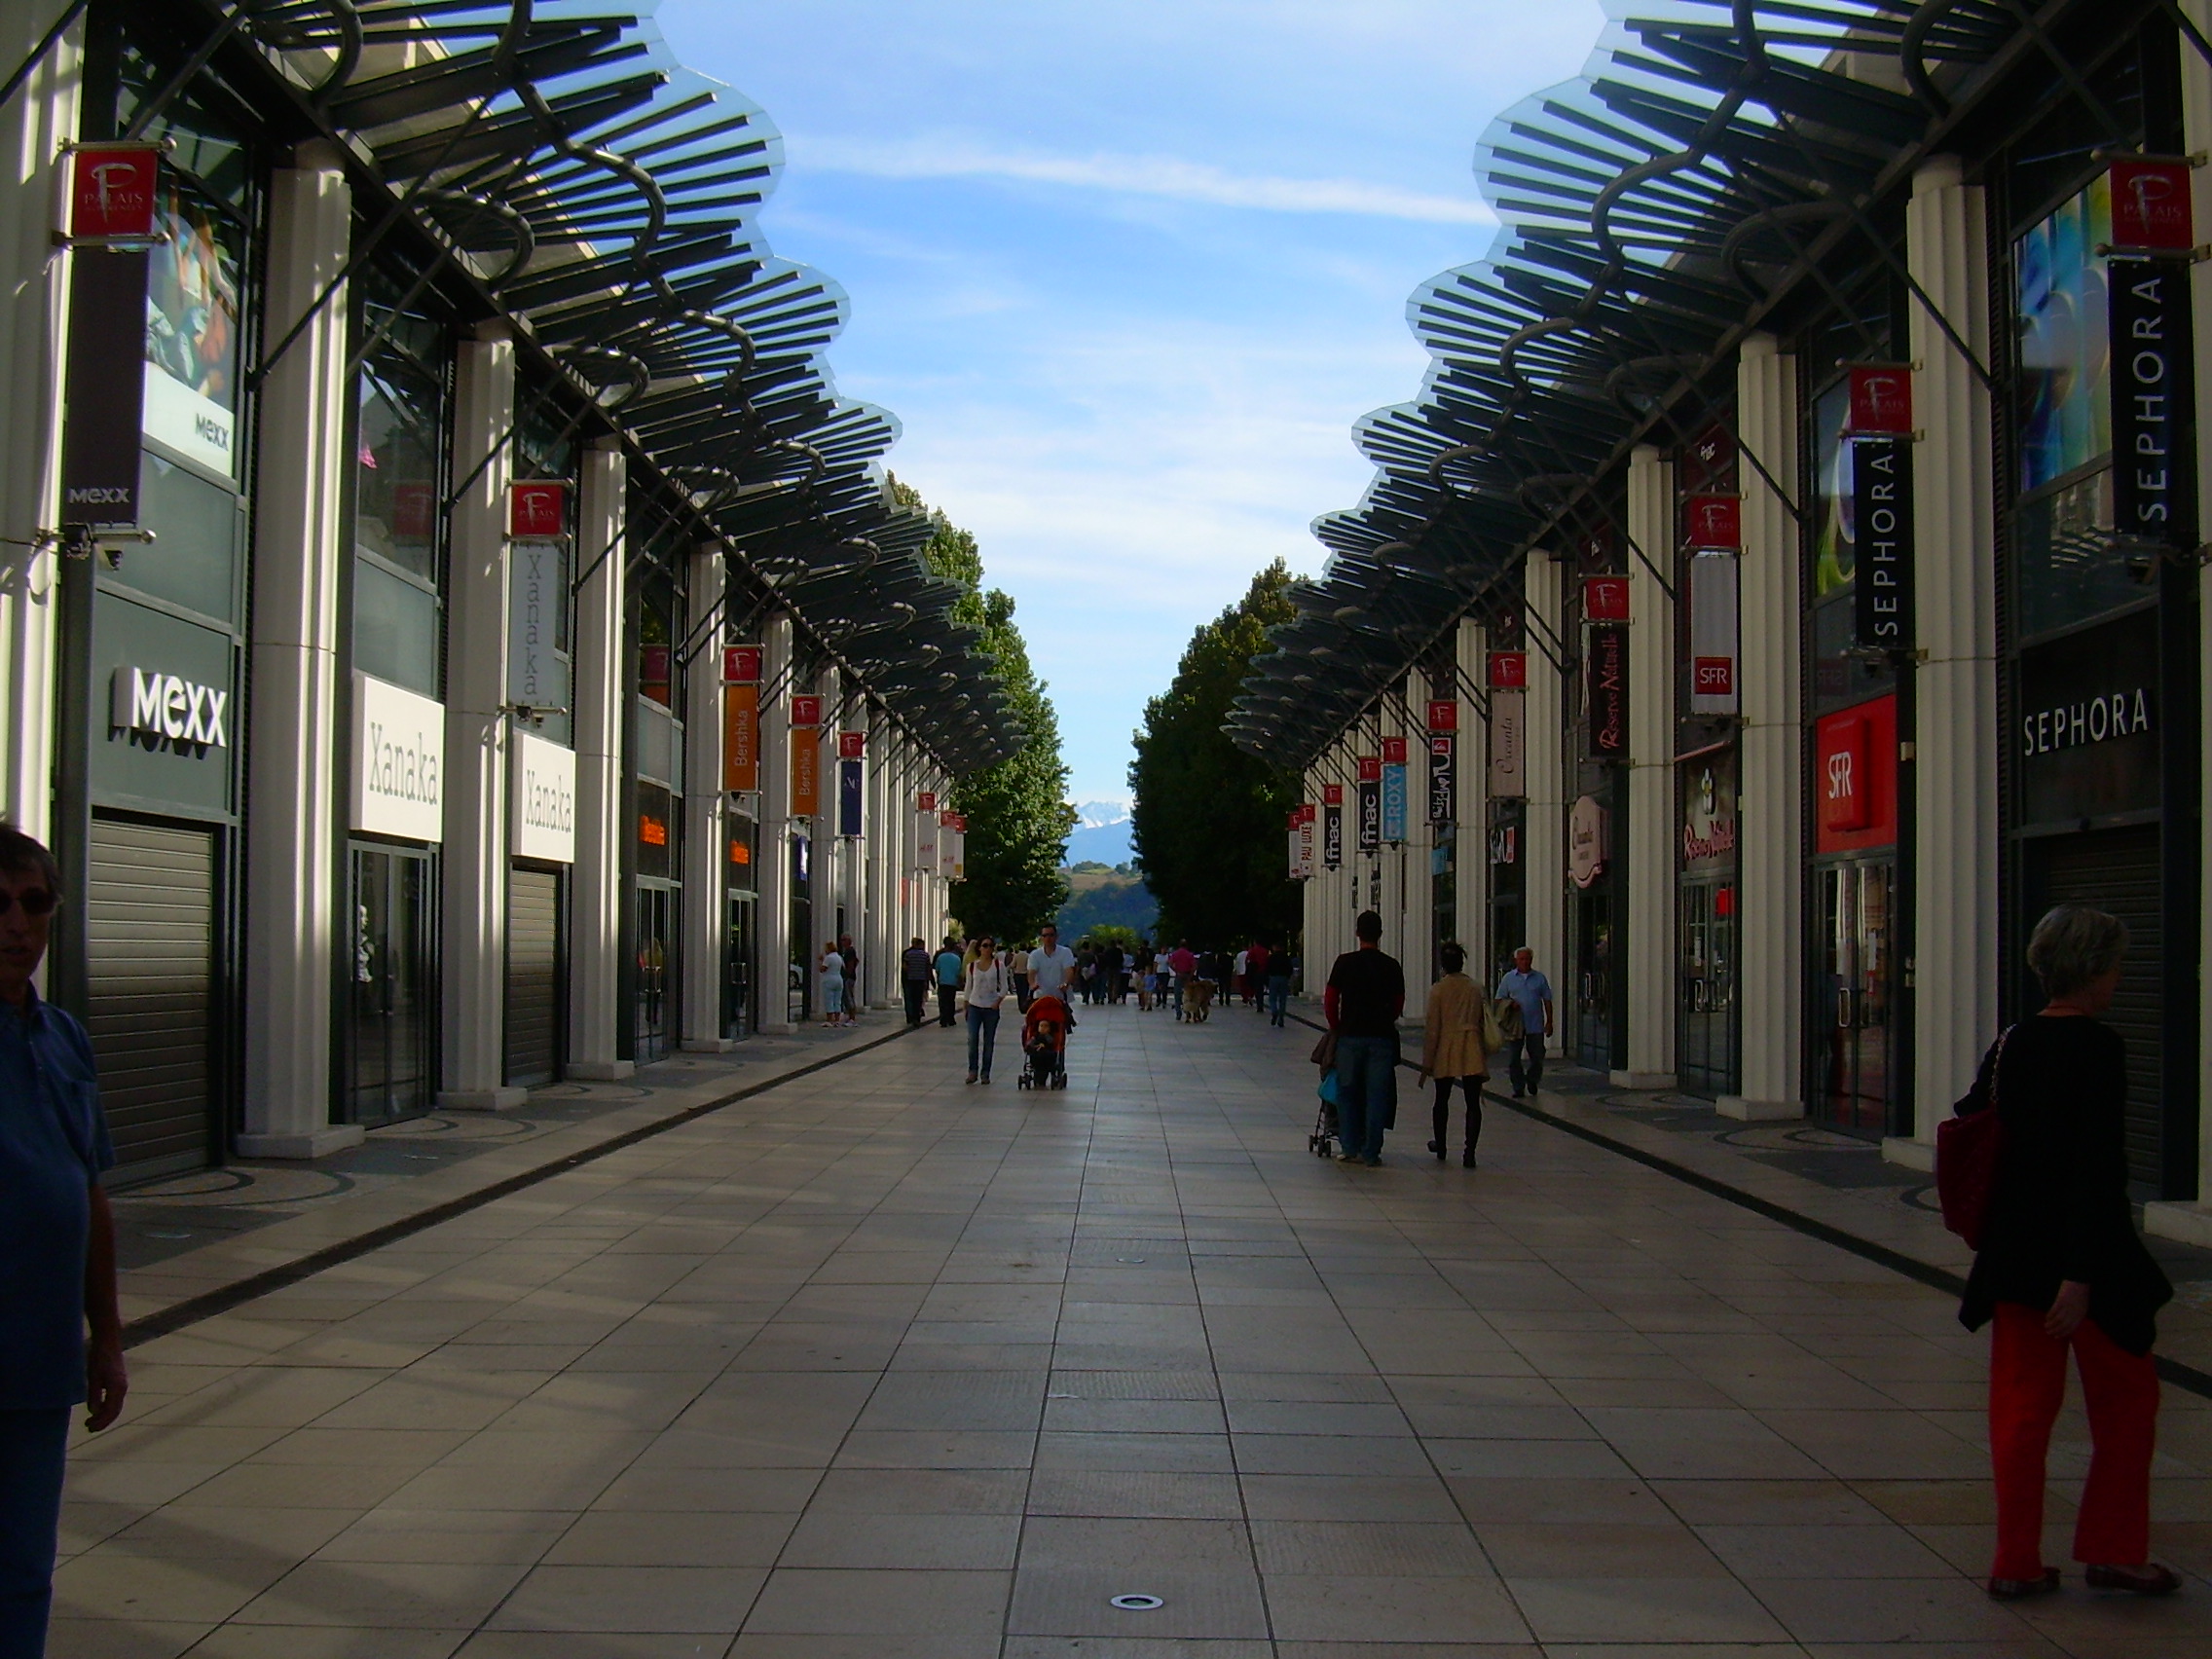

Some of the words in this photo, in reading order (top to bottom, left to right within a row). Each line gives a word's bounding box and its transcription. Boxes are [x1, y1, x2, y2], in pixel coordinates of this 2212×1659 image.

[2132, 276, 2168, 525] SEPHORA
[1871, 454, 1899, 638] SEPHORA
[524, 552, 543, 696] Xanaka
[1699, 666, 1728, 684] SFR
[734, 709, 749, 766] Bershka
[2024, 687, 2149, 757] SEPHORA
[369, 721, 438, 806] Xanaka
[798, 748, 812, 796] Bershka
[1828, 751, 1853, 799] SFR
[525, 767, 571, 833] Xanaka
[1361, 793, 1378, 845] fnac
[1387, 769, 1401, 818] ROXY
[1326, 816, 1340, 861] fnac
